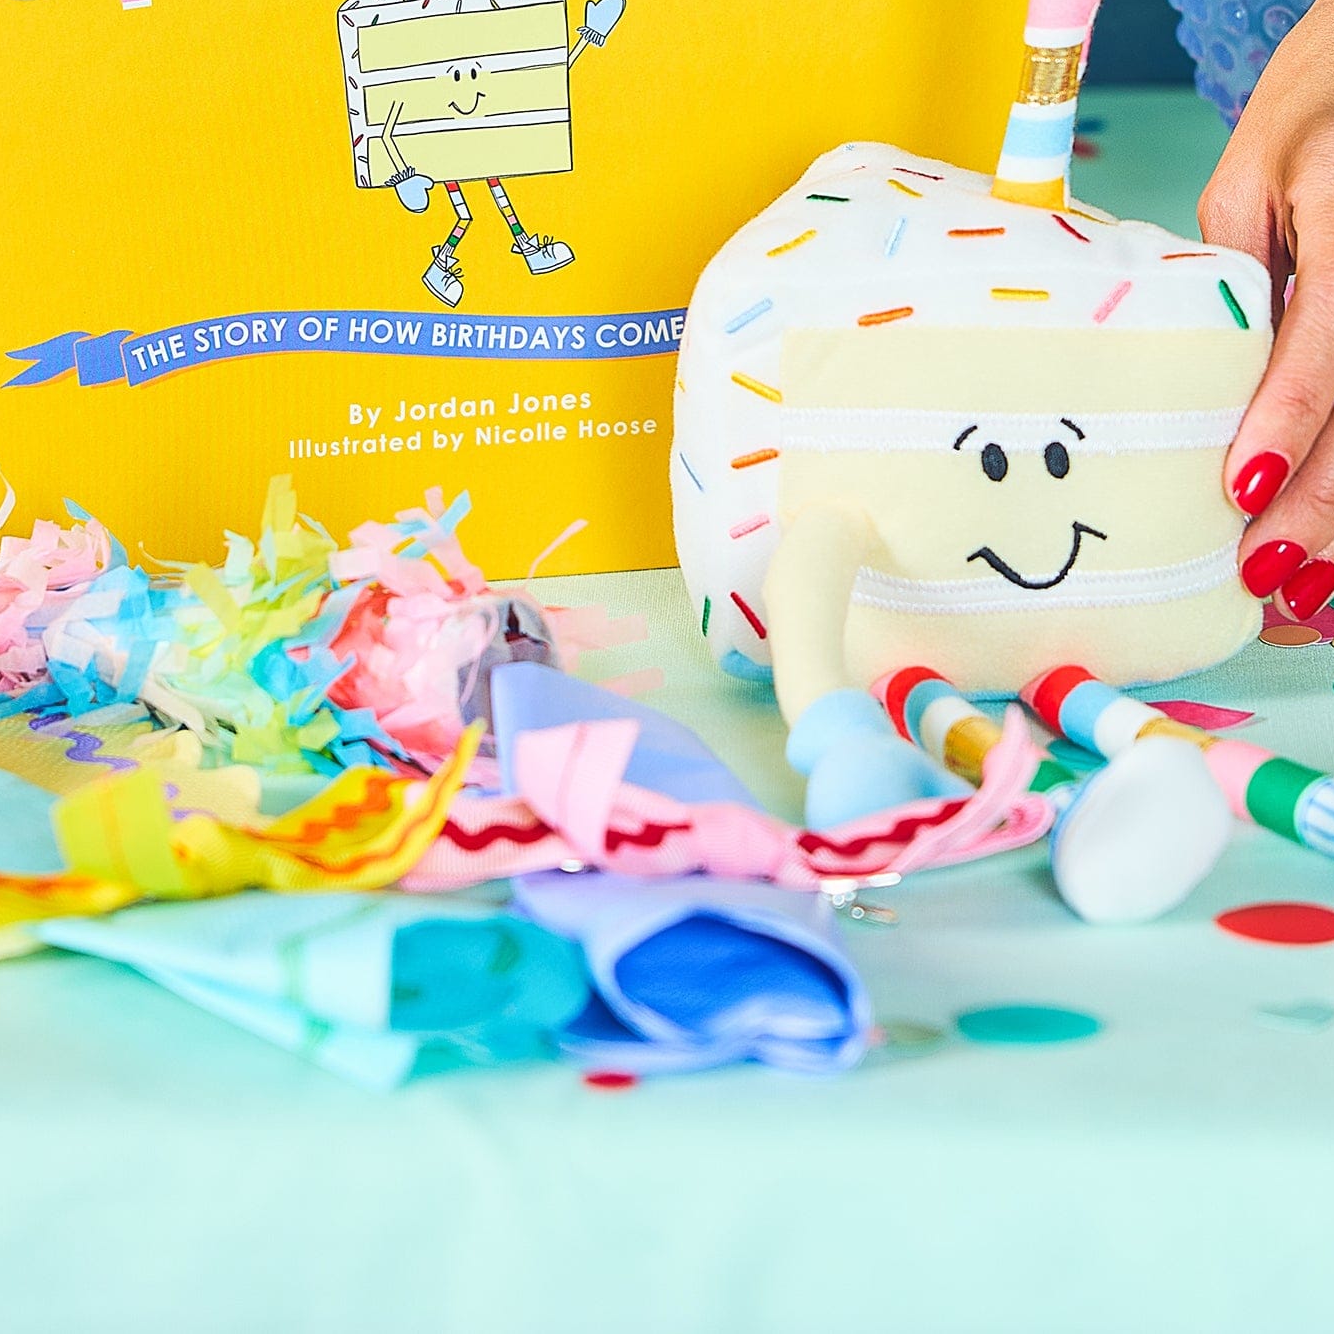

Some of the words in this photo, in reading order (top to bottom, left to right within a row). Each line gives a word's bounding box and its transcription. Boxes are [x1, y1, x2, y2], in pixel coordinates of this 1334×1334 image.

[131, 333, 186, 371] THE
[195, 317, 287, 353] STORY
[298, 316, 340, 342] OF
[349, 318, 422, 345] HOW
[595, 316, 684, 348] COME
[349, 403, 382, 429] By
[394, 397, 496, 422] Jordan
[508, 392, 593, 415] Jones
[289, 430, 422, 459] Illustrated
[433, 430, 465, 453] by
[475, 422, 568, 446] Nicolle
[578, 418, 658, 439] Hoose
